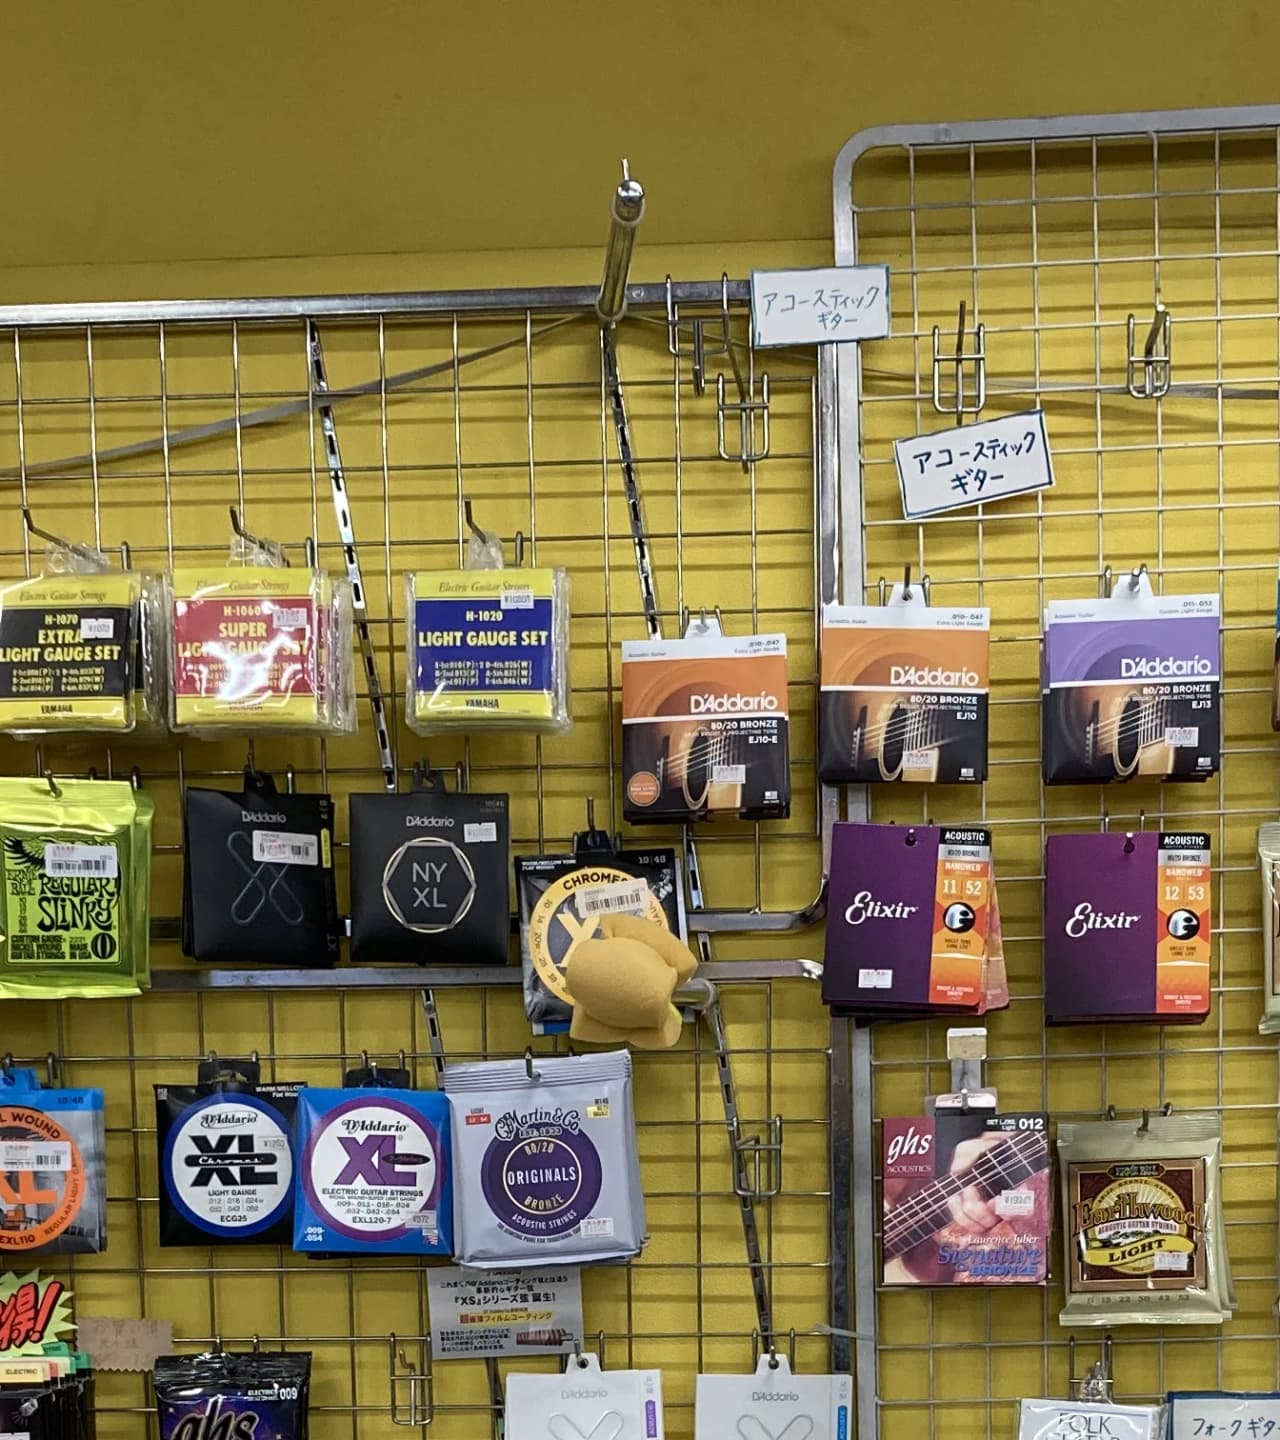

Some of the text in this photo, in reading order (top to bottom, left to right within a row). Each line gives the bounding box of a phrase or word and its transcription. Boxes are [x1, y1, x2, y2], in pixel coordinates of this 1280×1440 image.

[762, 287, 880, 313] アコースティック
[817, 312, 859, 329] ギター
[912, 431, 1037, 476] アコースティック
[950, 468, 1006, 495] ギター
[466, 611, 503, 623] H-1020
[419, 630, 548, 647] LIGHT GAUGE SET
[1121, 656, 1211, 678] D'Addario
[891, 666, 979, 687] D'Addario
[465, 698, 500, 709] YAMAHA
[691, 691, 778, 713] D'Addario
[910, 695, 978, 705] 80/20 BRONZE
[1192, 700, 1211, 710] EJ13
[956, 711, 977, 720] EJ10
[241, 810, 286, 824] D'Addario
[406, 816, 455, 829] D'Addario
[945, 831, 985, 842] ACOUSTIC
[412, 863, 445, 882] NY
[413, 886, 447, 907] XL
[846, 891, 917, 925] Elixir
[342, 1120, 408, 1134] D'Addario
[1019, 1117, 1044, 1131] 012
[888, 1128, 931, 1164] ghs
[507, 1167, 576, 1187] ORIGINALS
[322, 1188, 424, 1198] ELECTRIC GUITAR STRINGS
[524, 1193, 563, 1211] BRONZE
[938, 1243, 1041, 1266] Signature
